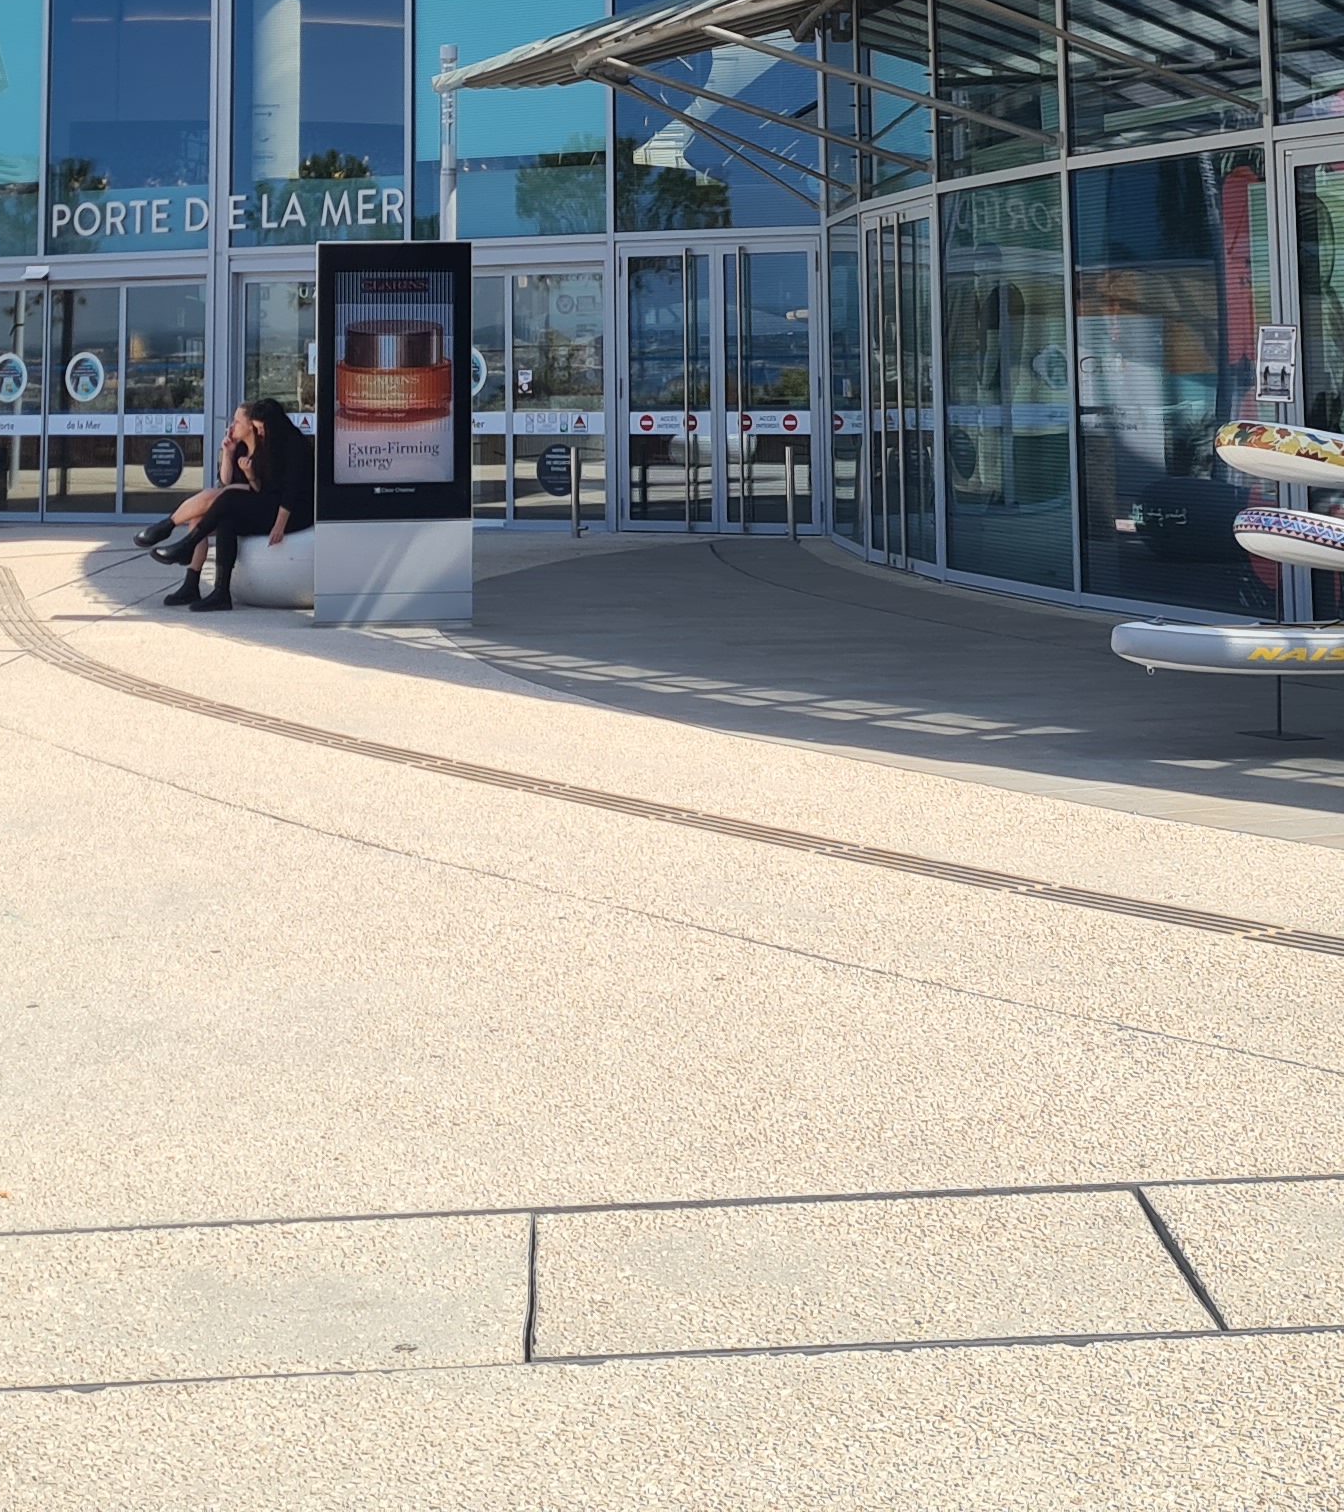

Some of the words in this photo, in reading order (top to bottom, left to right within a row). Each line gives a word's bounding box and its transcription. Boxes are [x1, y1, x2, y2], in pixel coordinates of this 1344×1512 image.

[51, 198, 171, 238] PORTE
[185, 194, 247, 232] DE
[262, 191, 307, 229] LA
[319, 188, 404, 228] MER
[66, 421, 76, 430] de
[85, 420, 101, 430] Mer
[348, 441, 440, 457] Extra-Firming
[348, 455, 393, 470] Energy
